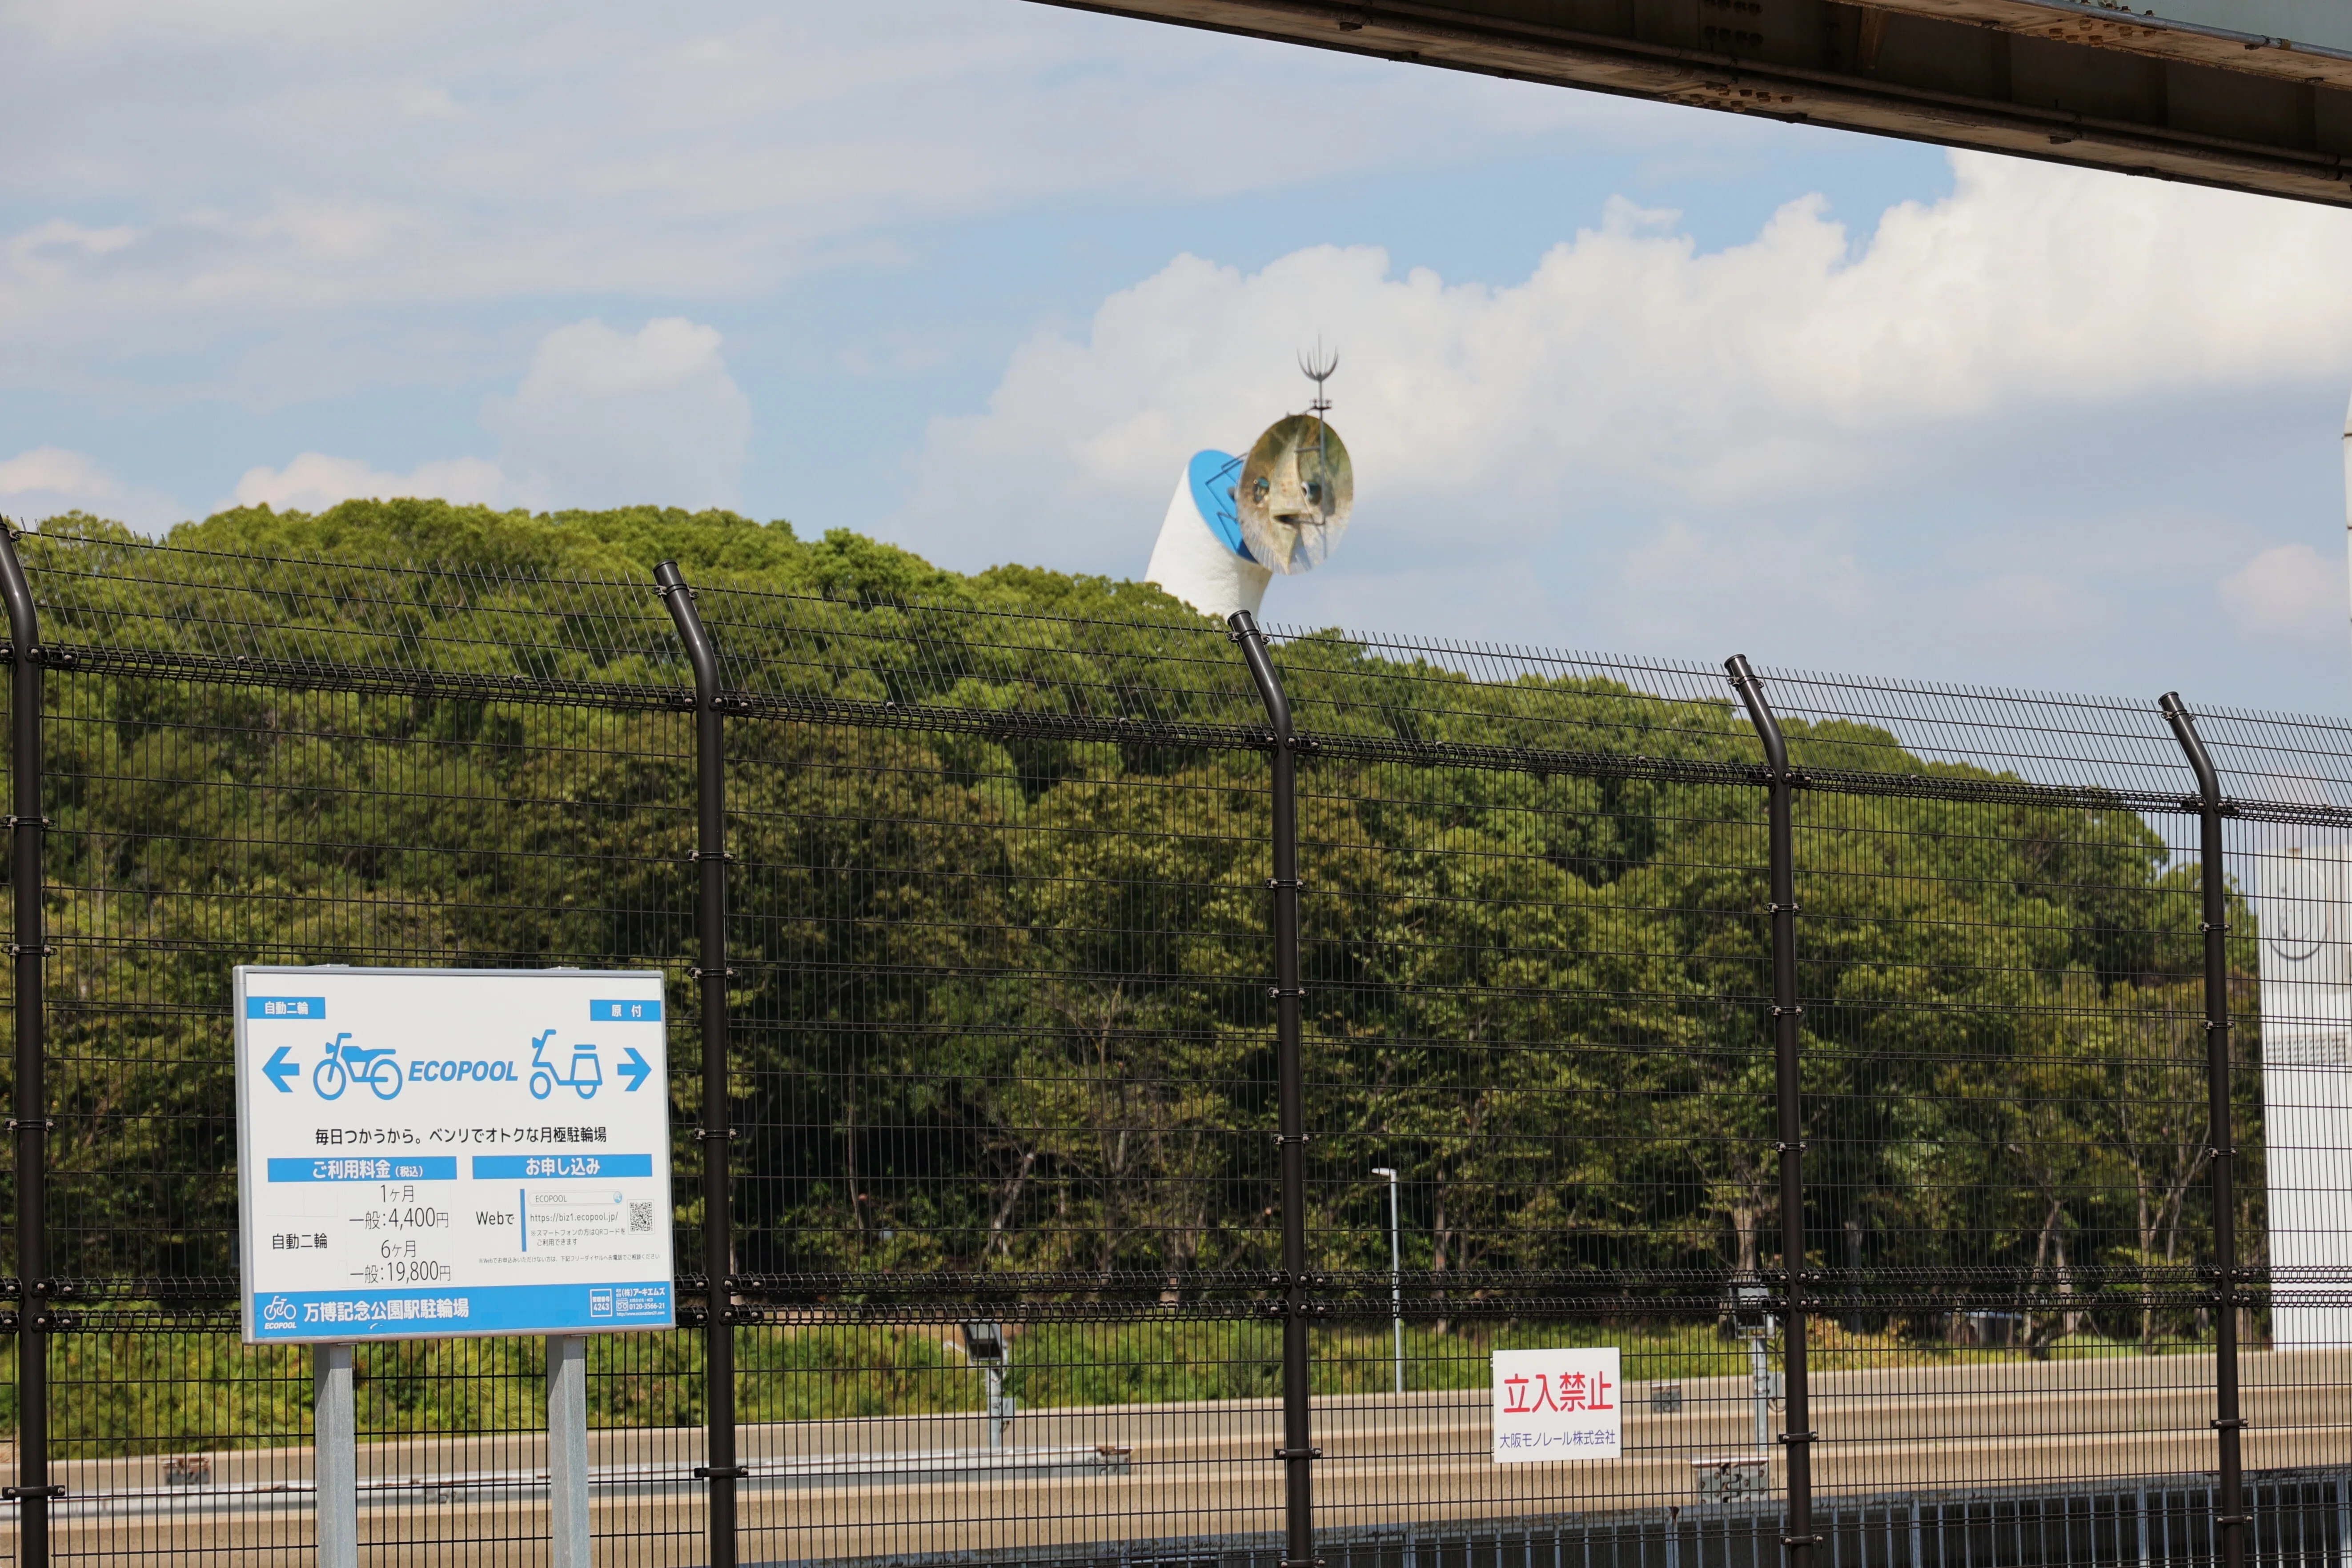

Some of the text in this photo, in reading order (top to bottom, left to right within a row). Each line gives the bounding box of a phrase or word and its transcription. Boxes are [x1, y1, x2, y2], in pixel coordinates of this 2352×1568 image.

[265, 1002, 309, 1016] 自動二輪
[409, 1061, 518, 1082] ECOPOOL
[315, 1127, 607, 1145] 毎日つかうから。ベンリでオトクな月極駐輪場
[526, 1159, 600, 1175] お申し込み
[476, 1211, 514, 1225] Webで
[530, 1211, 618, 1223] https://biz1.ecopool.jp/
[272, 1233, 328, 1250] 自動二輪
[536, 1238, 578, 1246] ご利用できます
[303, 1299, 470, 1322] 万博記念公園駅駐輪場
[1503, 1371, 1613, 1413] 立入禁止
[1499, 1429, 1616, 1449] 大阪モノレール株式会社
